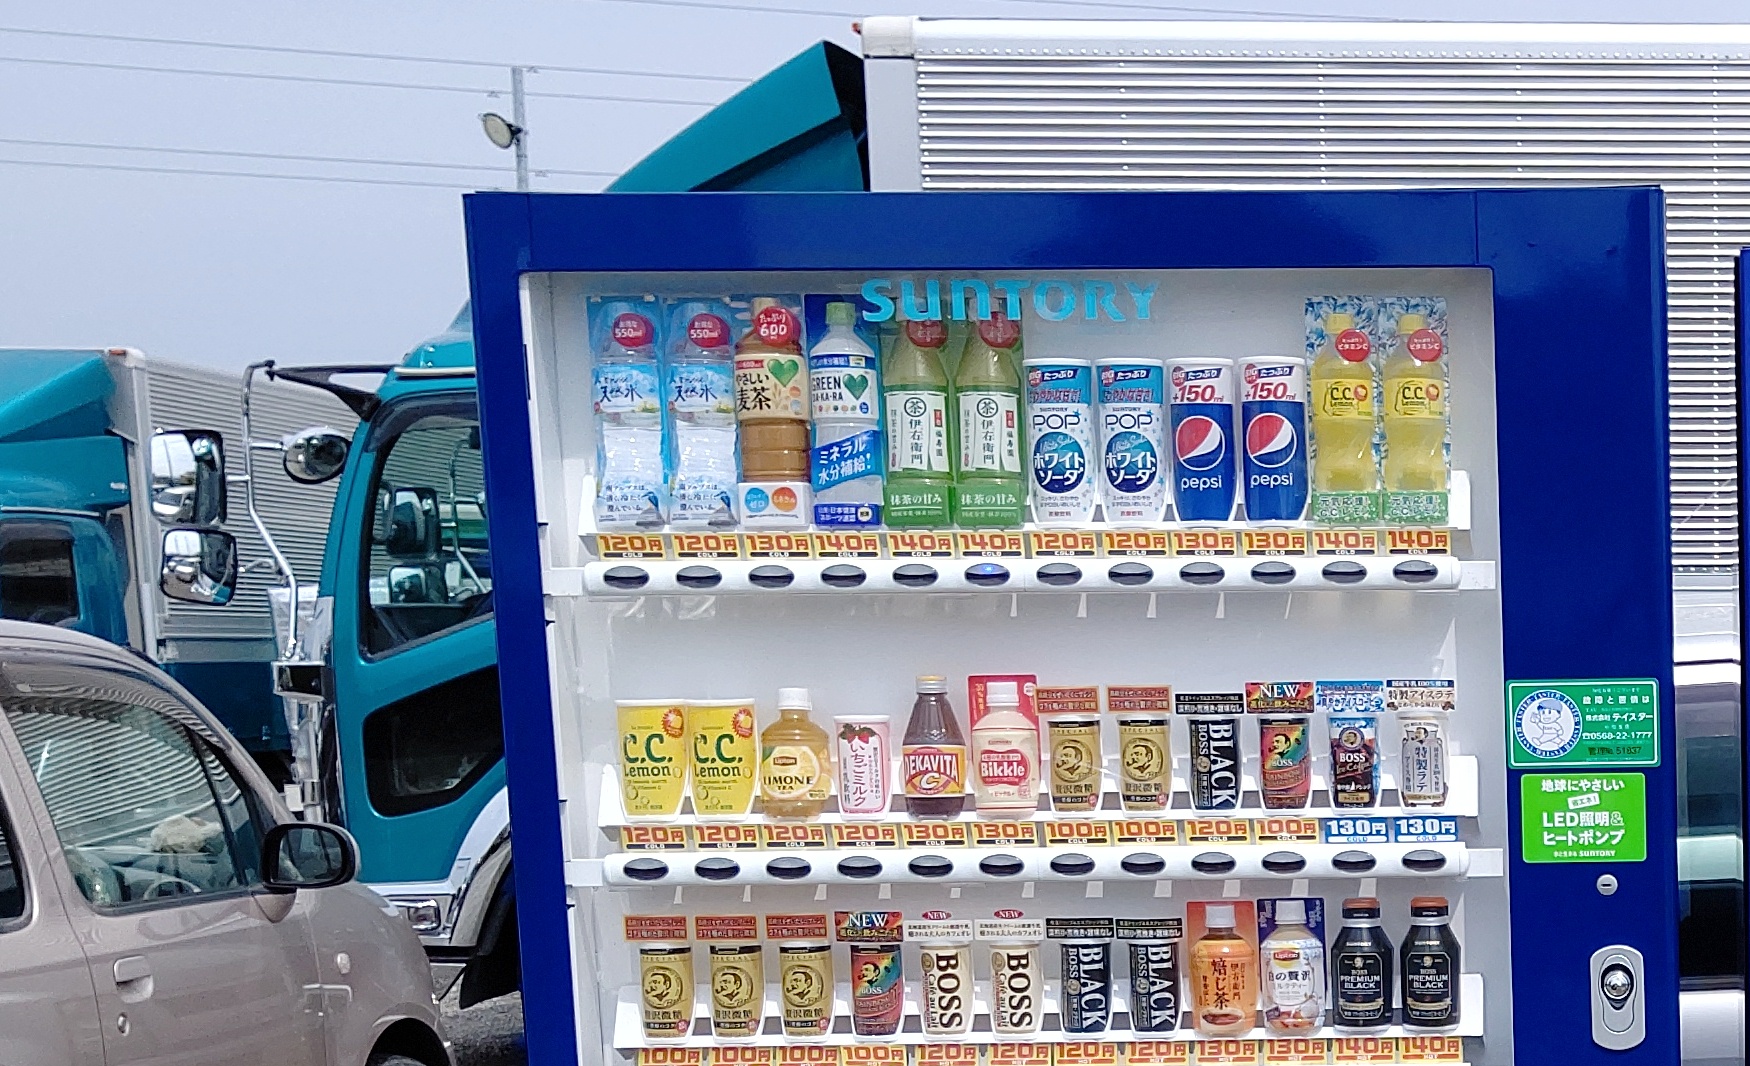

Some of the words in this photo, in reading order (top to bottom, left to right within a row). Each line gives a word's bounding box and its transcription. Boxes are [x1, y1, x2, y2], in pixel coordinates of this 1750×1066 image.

[760, 324, 788, 337] 600
[736, 372, 770, 386] やさしい
[811, 375, 841, 391] GREEN
[1044, 369, 1074, 381] たっぷり
[737, 386, 772, 411] 麦茶
[1330, 387, 1355, 400] C.C.
[906, 399, 924, 416] 茶
[1033, 414, 1080, 429] POP
[909, 418, 924, 466] 伊右衛門
[819, 438, 866, 465] ミネラル
[1034, 452, 1083, 468] ホワイト
[1040, 467, 1083, 485] ソーダ
[1181, 473, 1223, 491] pepsi
[1250, 472, 1293, 490] pepsi
[889, 493, 943, 506] 抹茶の甘み
[1259, 684, 1300, 698] NEW
[1388, 690, 1453, 700] 特製アイスラテ
[1612, 712, 1653, 721] テイスター
[1198, 724, 1209, 755] BOSS
[1209, 723, 1236, 808] BLACK
[1339, 753, 1366, 763] BOSS
[624, 764, 671, 778] Lemon
[850, 742, 868, 808] いちごミルク
[904, 754, 959, 782] DEKAVITA
[981, 761, 1026, 778] Bikkle
[1414, 745, 1429, 793] 特製ラテ
[763, 775, 814, 786] LIMONE
[920, 772, 940, 790] C
[1541, 779, 1625, 792] 地球にやさしい
[1543, 830, 1625, 846] ヒートポンプ
[849, 913, 888, 928] NEW
[1079, 945, 1107, 1030] BLACK
[1211, 958, 1230, 1010] 焙じ茶
